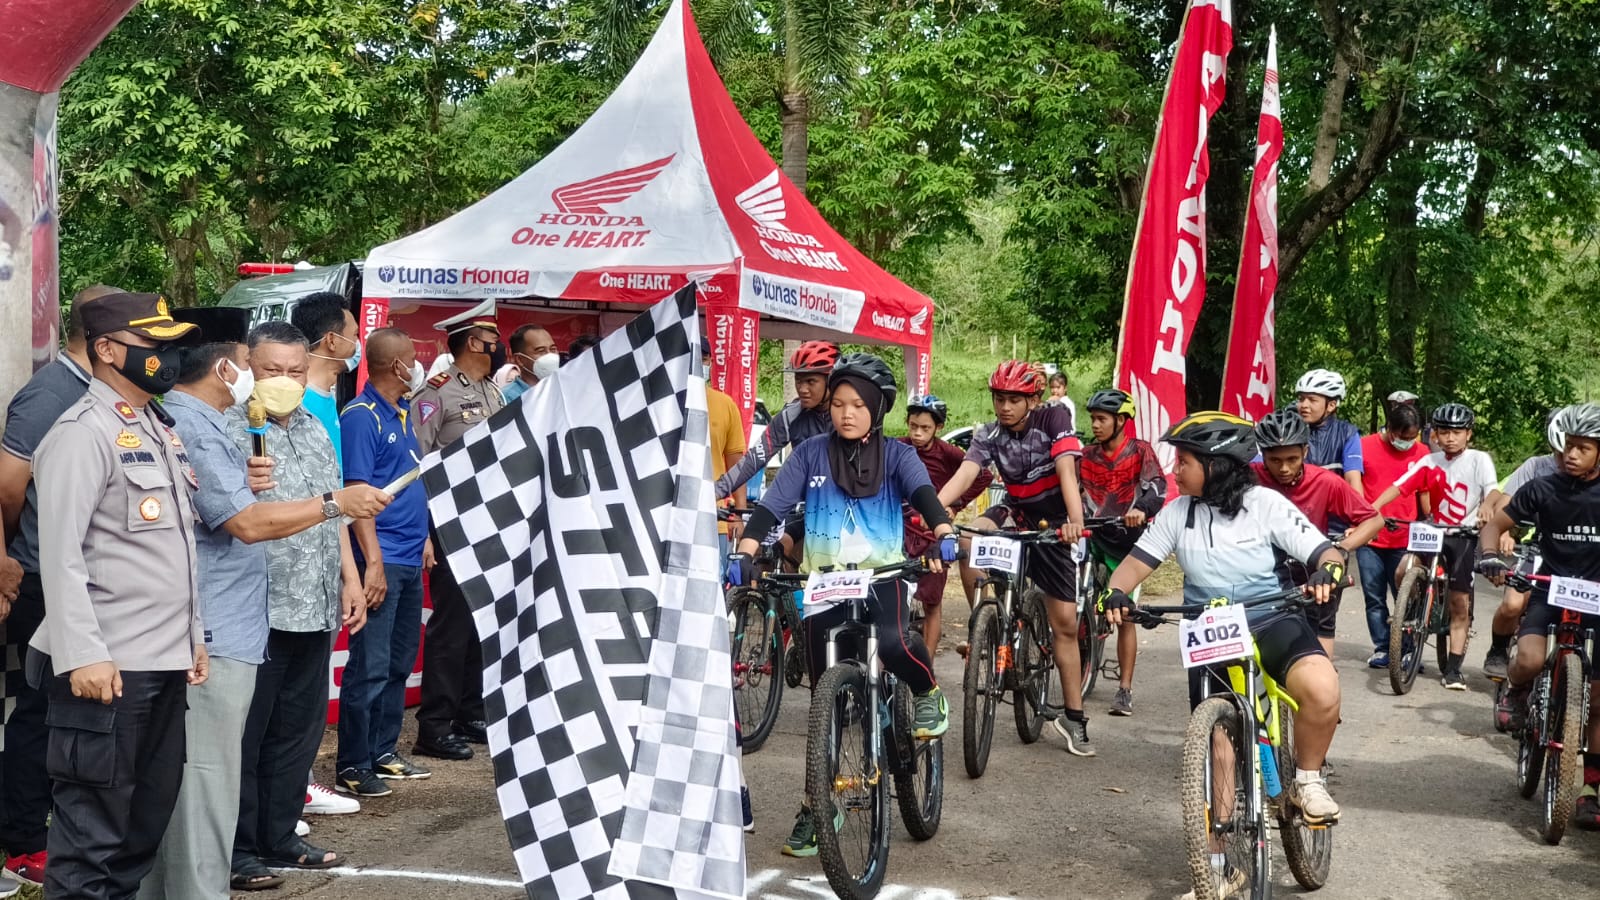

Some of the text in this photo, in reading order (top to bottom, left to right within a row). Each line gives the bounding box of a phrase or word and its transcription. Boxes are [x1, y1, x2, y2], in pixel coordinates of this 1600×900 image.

[536, 213, 645, 227] HONDA
[511, 227, 652, 248] One HEART.
[752, 225, 824, 249] HONDA
[759, 239, 798, 264] One
[398, 265, 530, 285] tunas Honda
[599, 272, 672, 291] One HEART.
[762, 277, 798, 306] tunas
[799, 286, 837, 315] Honda
[977, 546, 1012, 559] B 010
[1556, 584, 1599, 602] B 002
[1187, 623, 1242, 648] A 002
